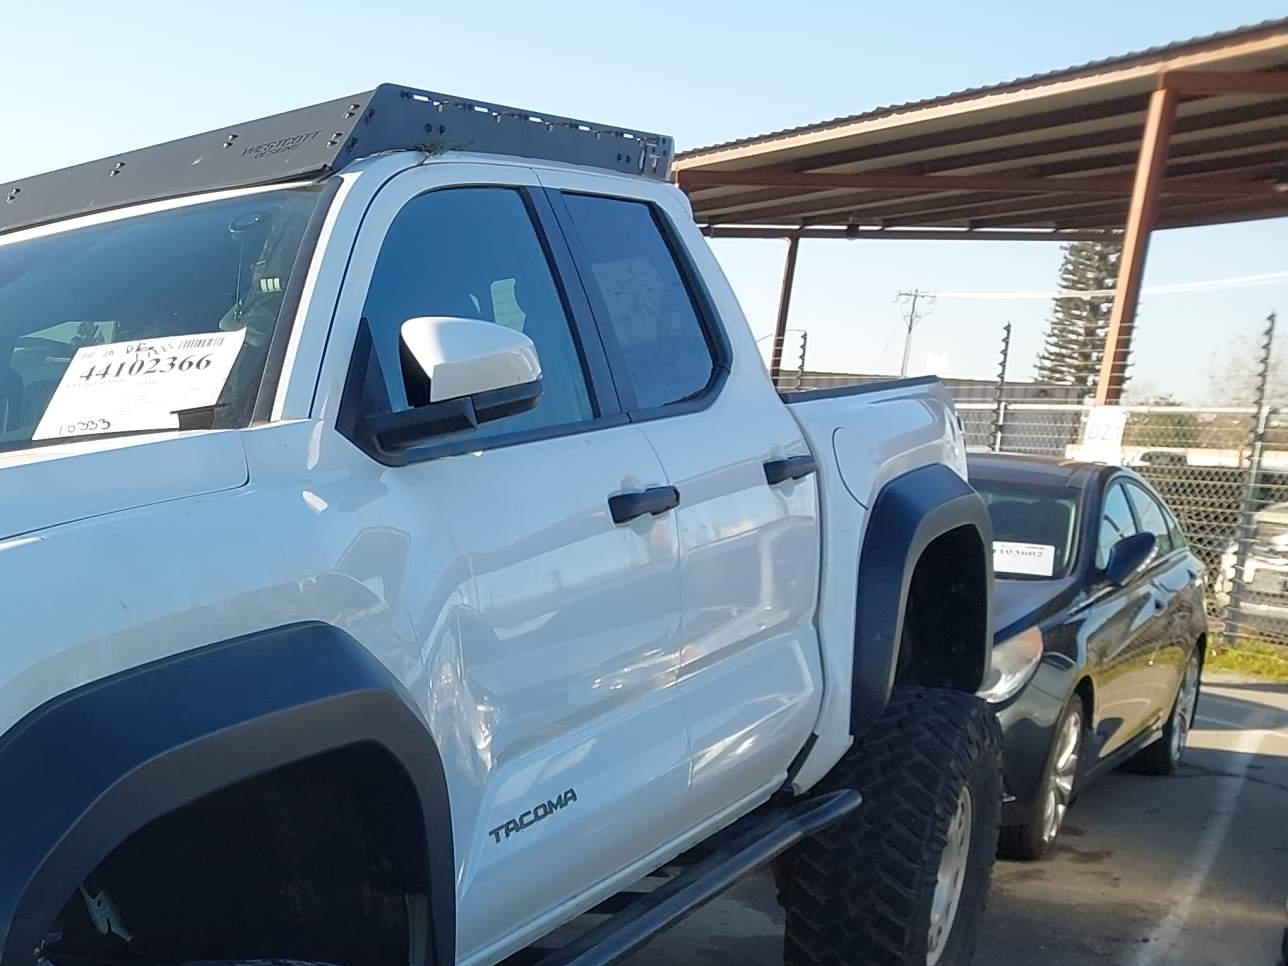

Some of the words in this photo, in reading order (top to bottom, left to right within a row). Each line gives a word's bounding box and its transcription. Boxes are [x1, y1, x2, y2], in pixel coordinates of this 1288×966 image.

[242, 130, 322, 156] WESTCOTT
[80, 352, 215, 381] 44102366
[488, 787, 578, 844] TACOMA
